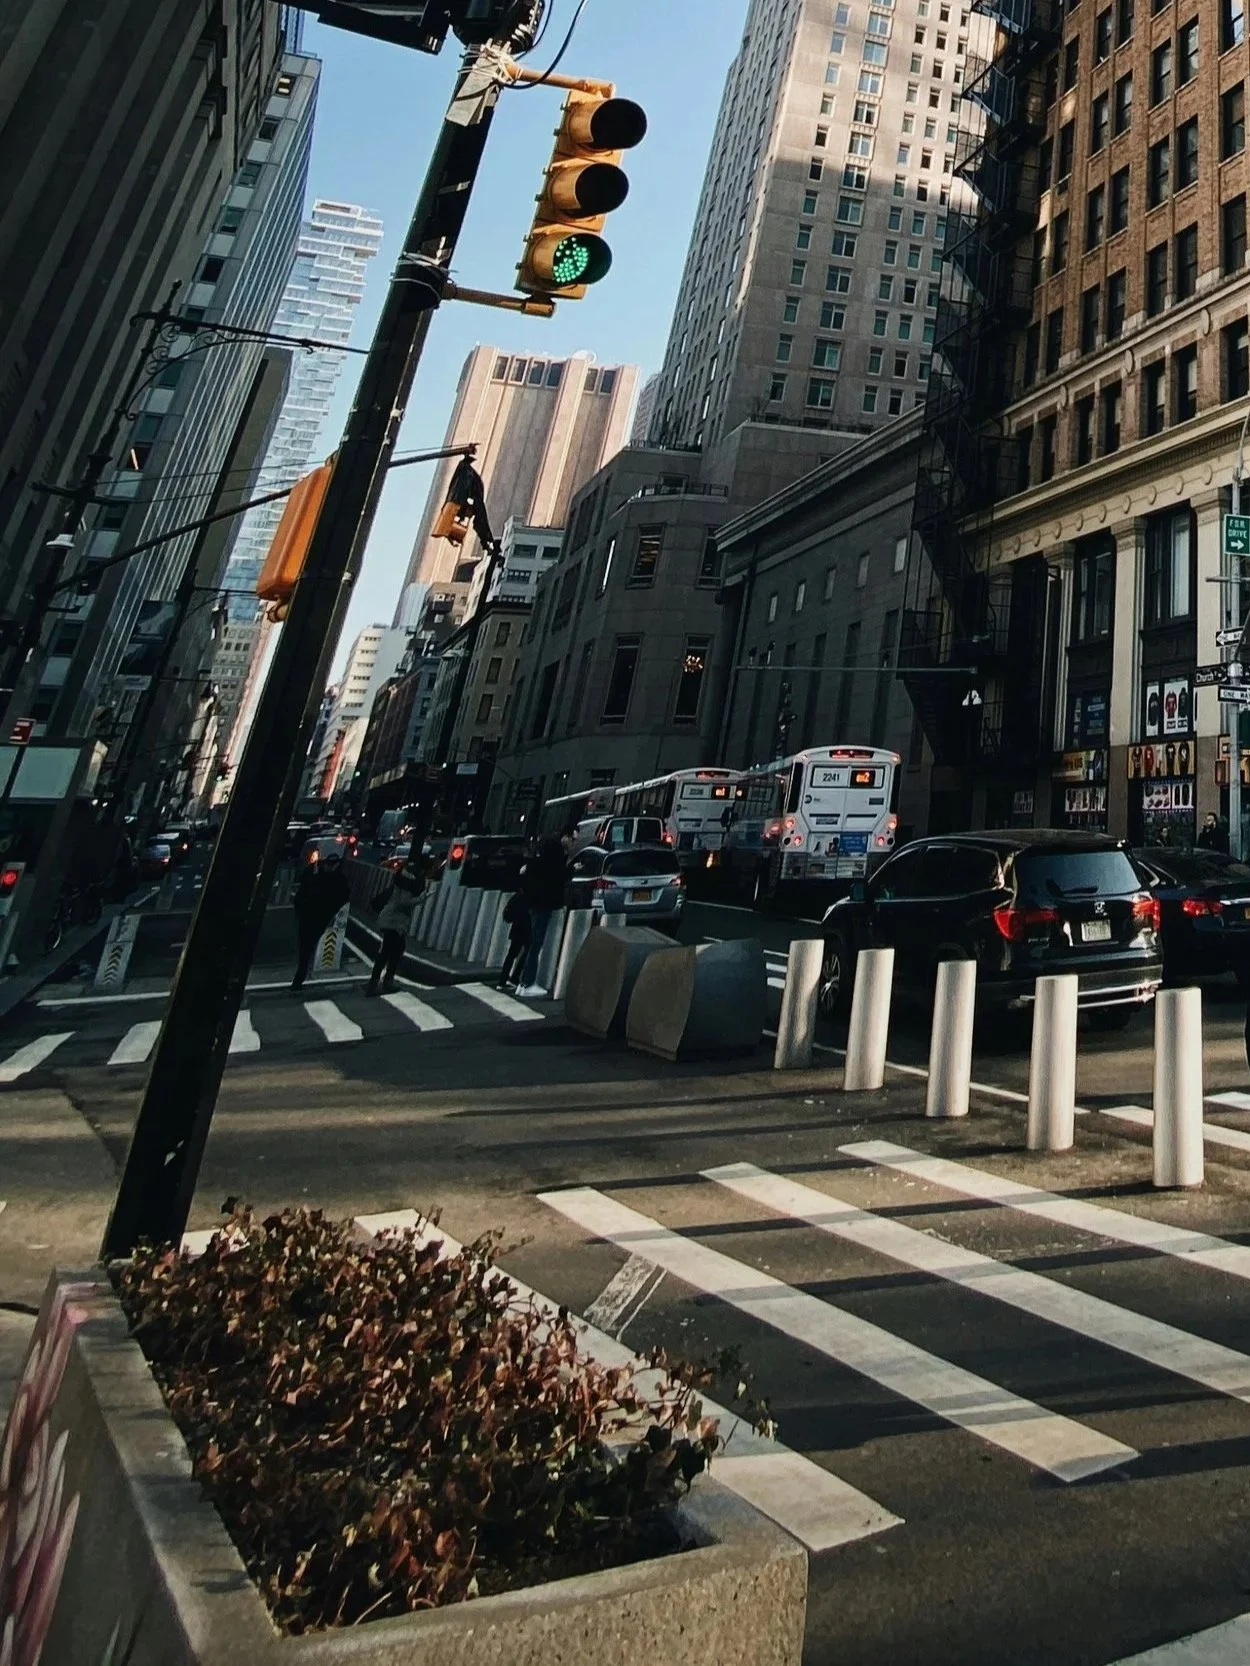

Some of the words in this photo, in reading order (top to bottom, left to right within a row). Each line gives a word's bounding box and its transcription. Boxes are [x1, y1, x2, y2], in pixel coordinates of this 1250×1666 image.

[1227, 528, 1247, 539] DRIVE
[1223, 690, 1235, 698] ONE
[822, 773, 840, 782] 2241
